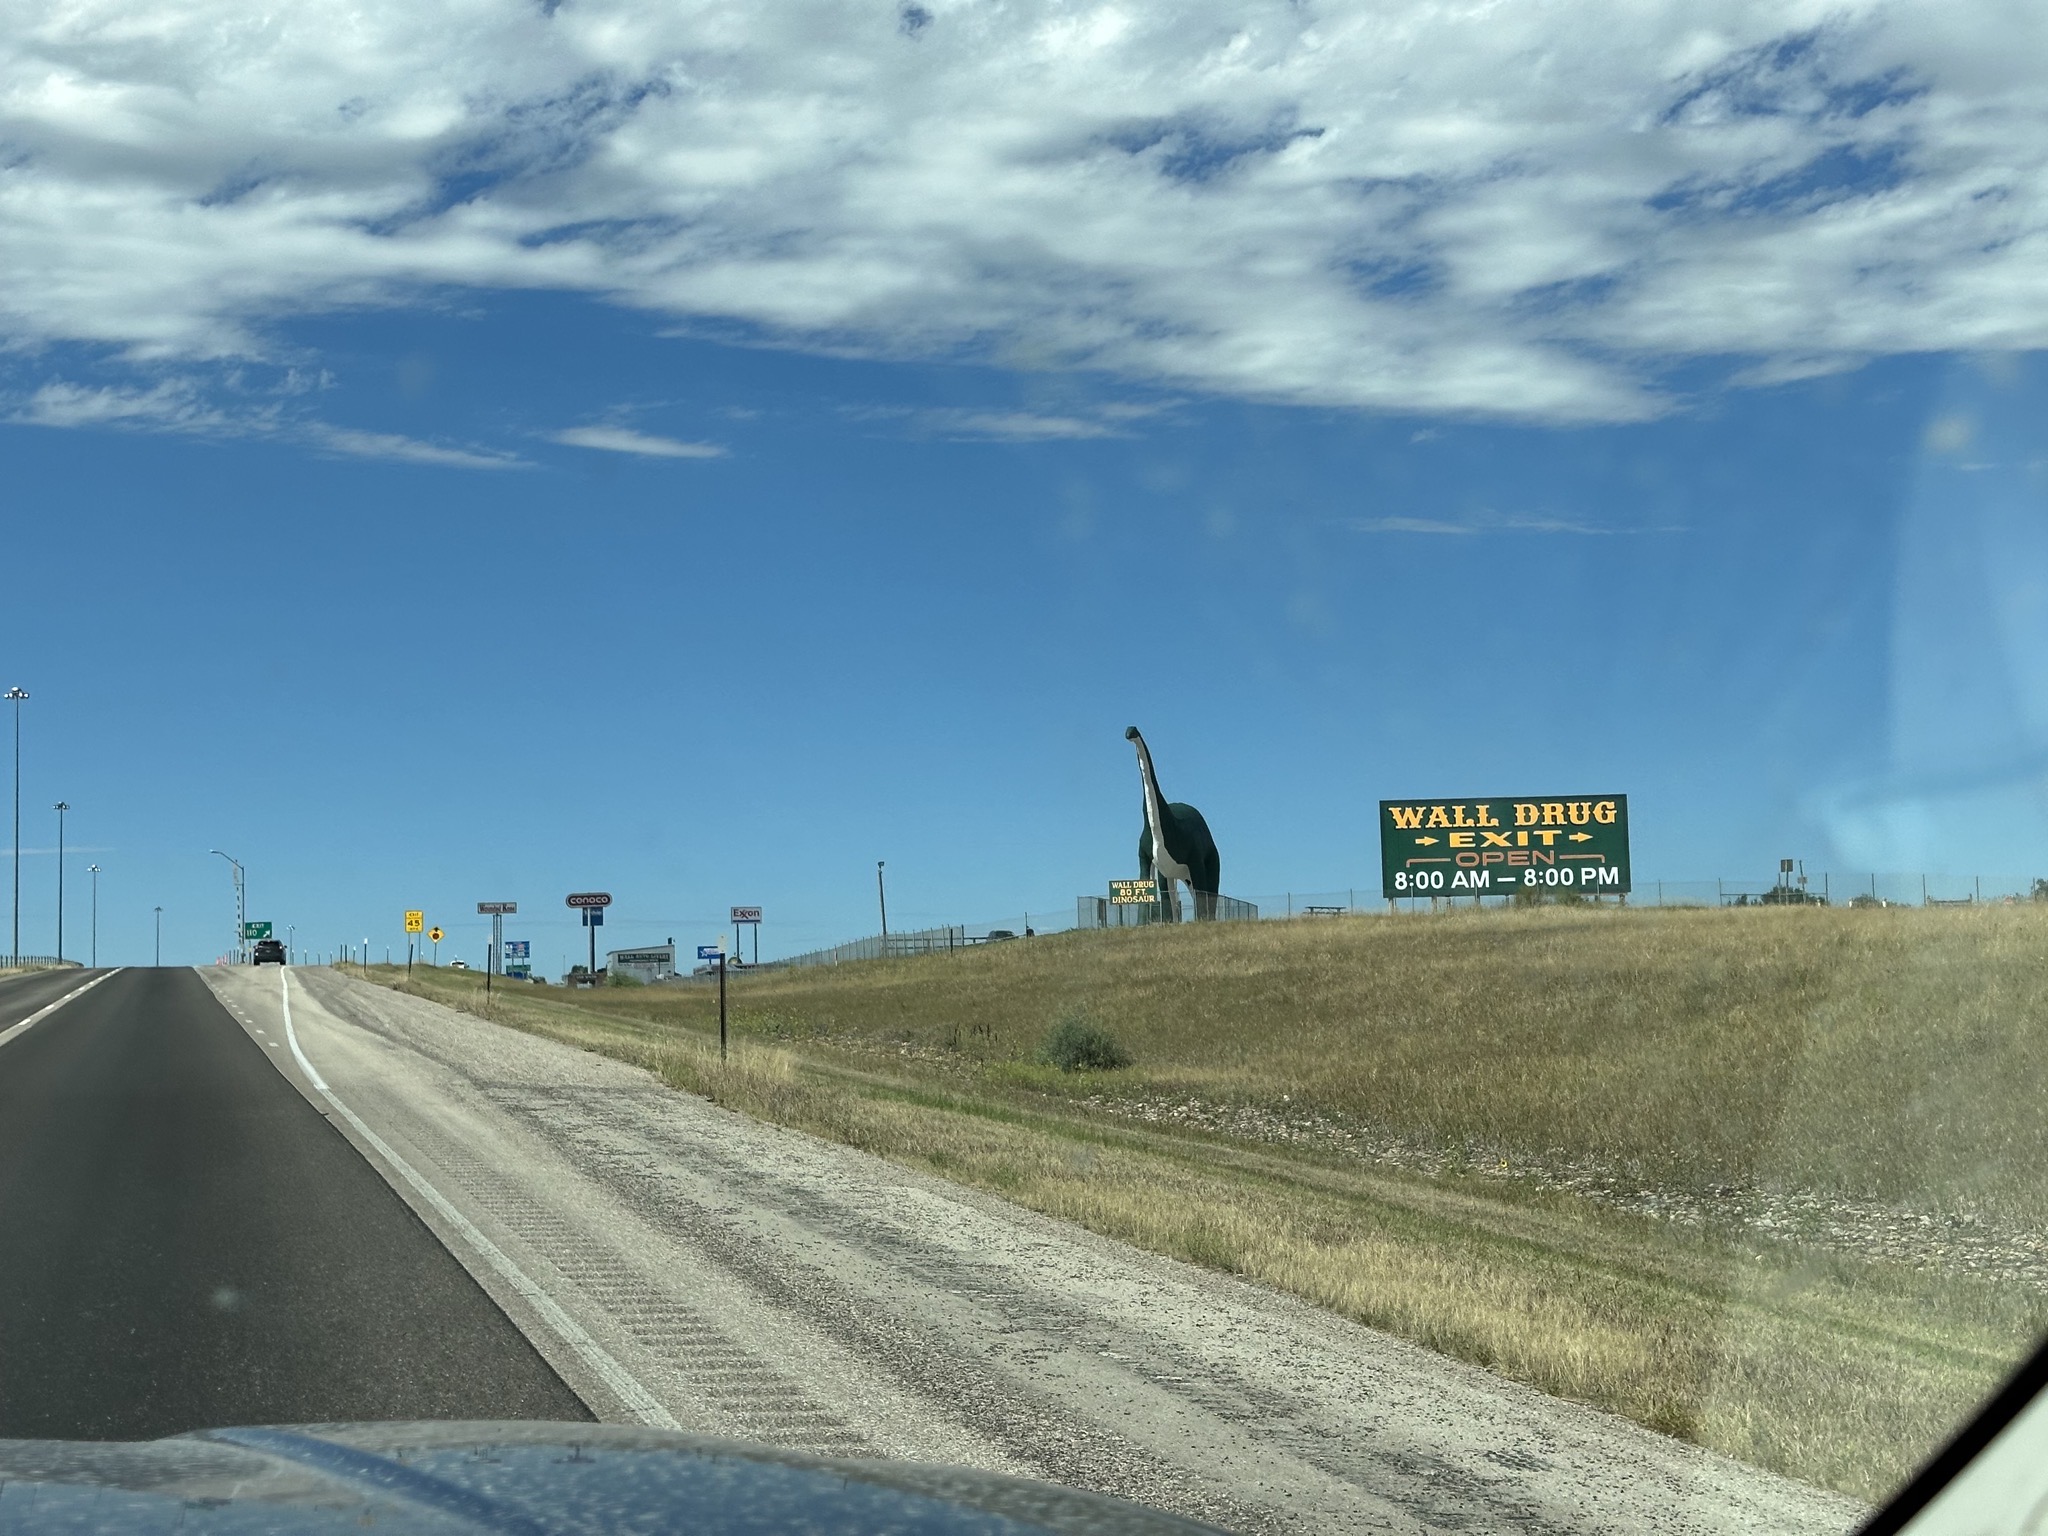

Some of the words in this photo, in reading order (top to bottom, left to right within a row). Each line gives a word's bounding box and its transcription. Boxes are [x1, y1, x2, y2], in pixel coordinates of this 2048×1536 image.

[1388, 804, 1499, 829] WALL
[1513, 801, 1617, 826] DRUG
[1449, 830, 1562, 848] EXIT
[1455, 850, 1555, 867] OPEN
[1394, 871, 1444, 890] 8:00
[1451, 870, 1490, 888] AM
[1523, 867, 1574, 887] 8:00
[1581, 866, 1619, 886] PM
[1112, 895, 1156, 904] DINOSAUR
[733, 909, 760, 919] Exxon
